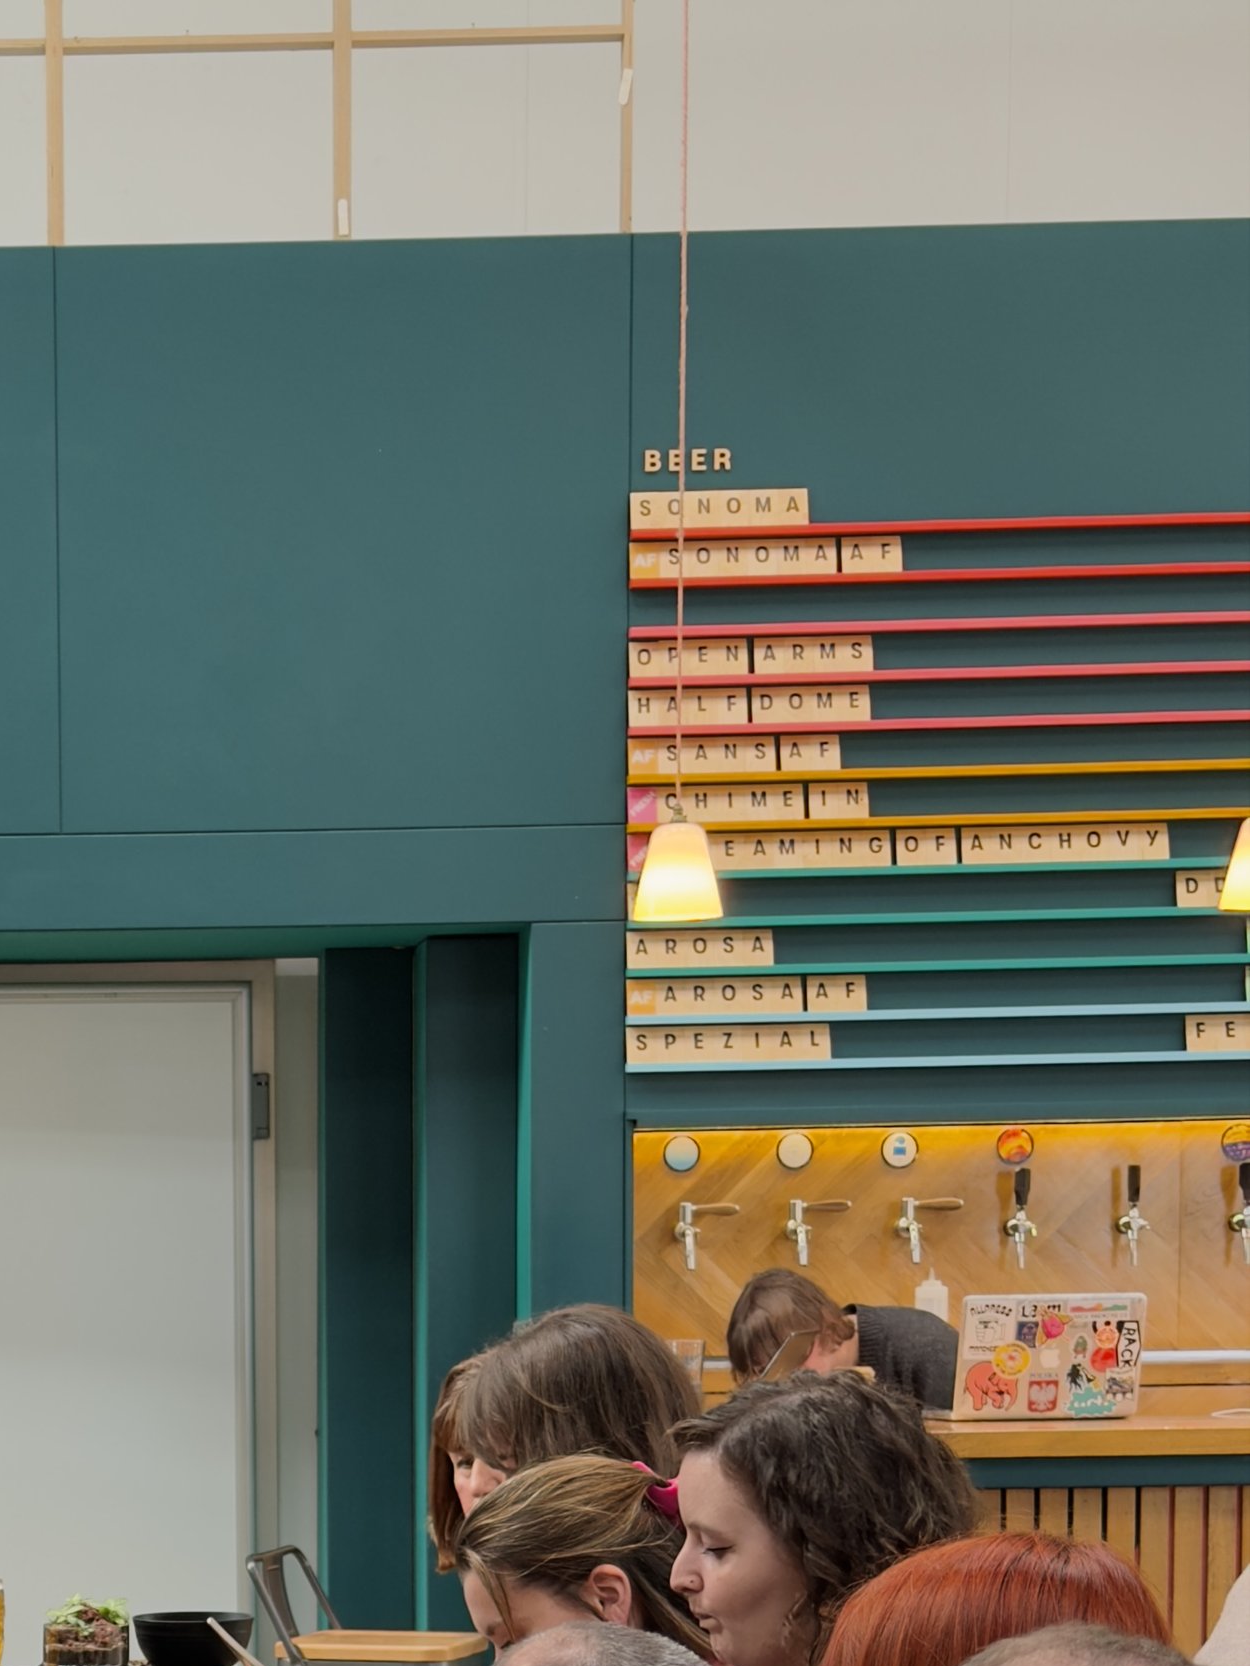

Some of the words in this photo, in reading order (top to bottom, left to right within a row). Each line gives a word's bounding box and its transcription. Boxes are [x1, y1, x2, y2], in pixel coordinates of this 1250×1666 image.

[643, 447, 733, 473] BEER
[639, 495, 800, 516] SONOMA
[633, 553, 657, 569] AF
[667, 545, 828, 565] SONOMA
[850, 543, 892, 561] AF
[637, 645, 739, 665] OPEN
[762, 642, 863, 661] ARMS
[637, 694, 738, 714] HALF
[759, 691, 860, 710] DOME
[631, 749, 656, 765] AF
[665, 743, 766, 760] SANS
[788, 741, 830, 758] AF
[664, 791, 794, 811] CHIME
[820, 789, 860, 807] IN
[904, 835, 946, 853] OF
[970, 830, 1159, 851] ANCHOVY
[635, 936, 766, 955] AROSA
[630, 992, 653, 1006] AF
[663, 983, 795, 1003] AROSA
[815, 981, 856, 999] AF
[635, 1029, 820, 1051] SPEZIAL
